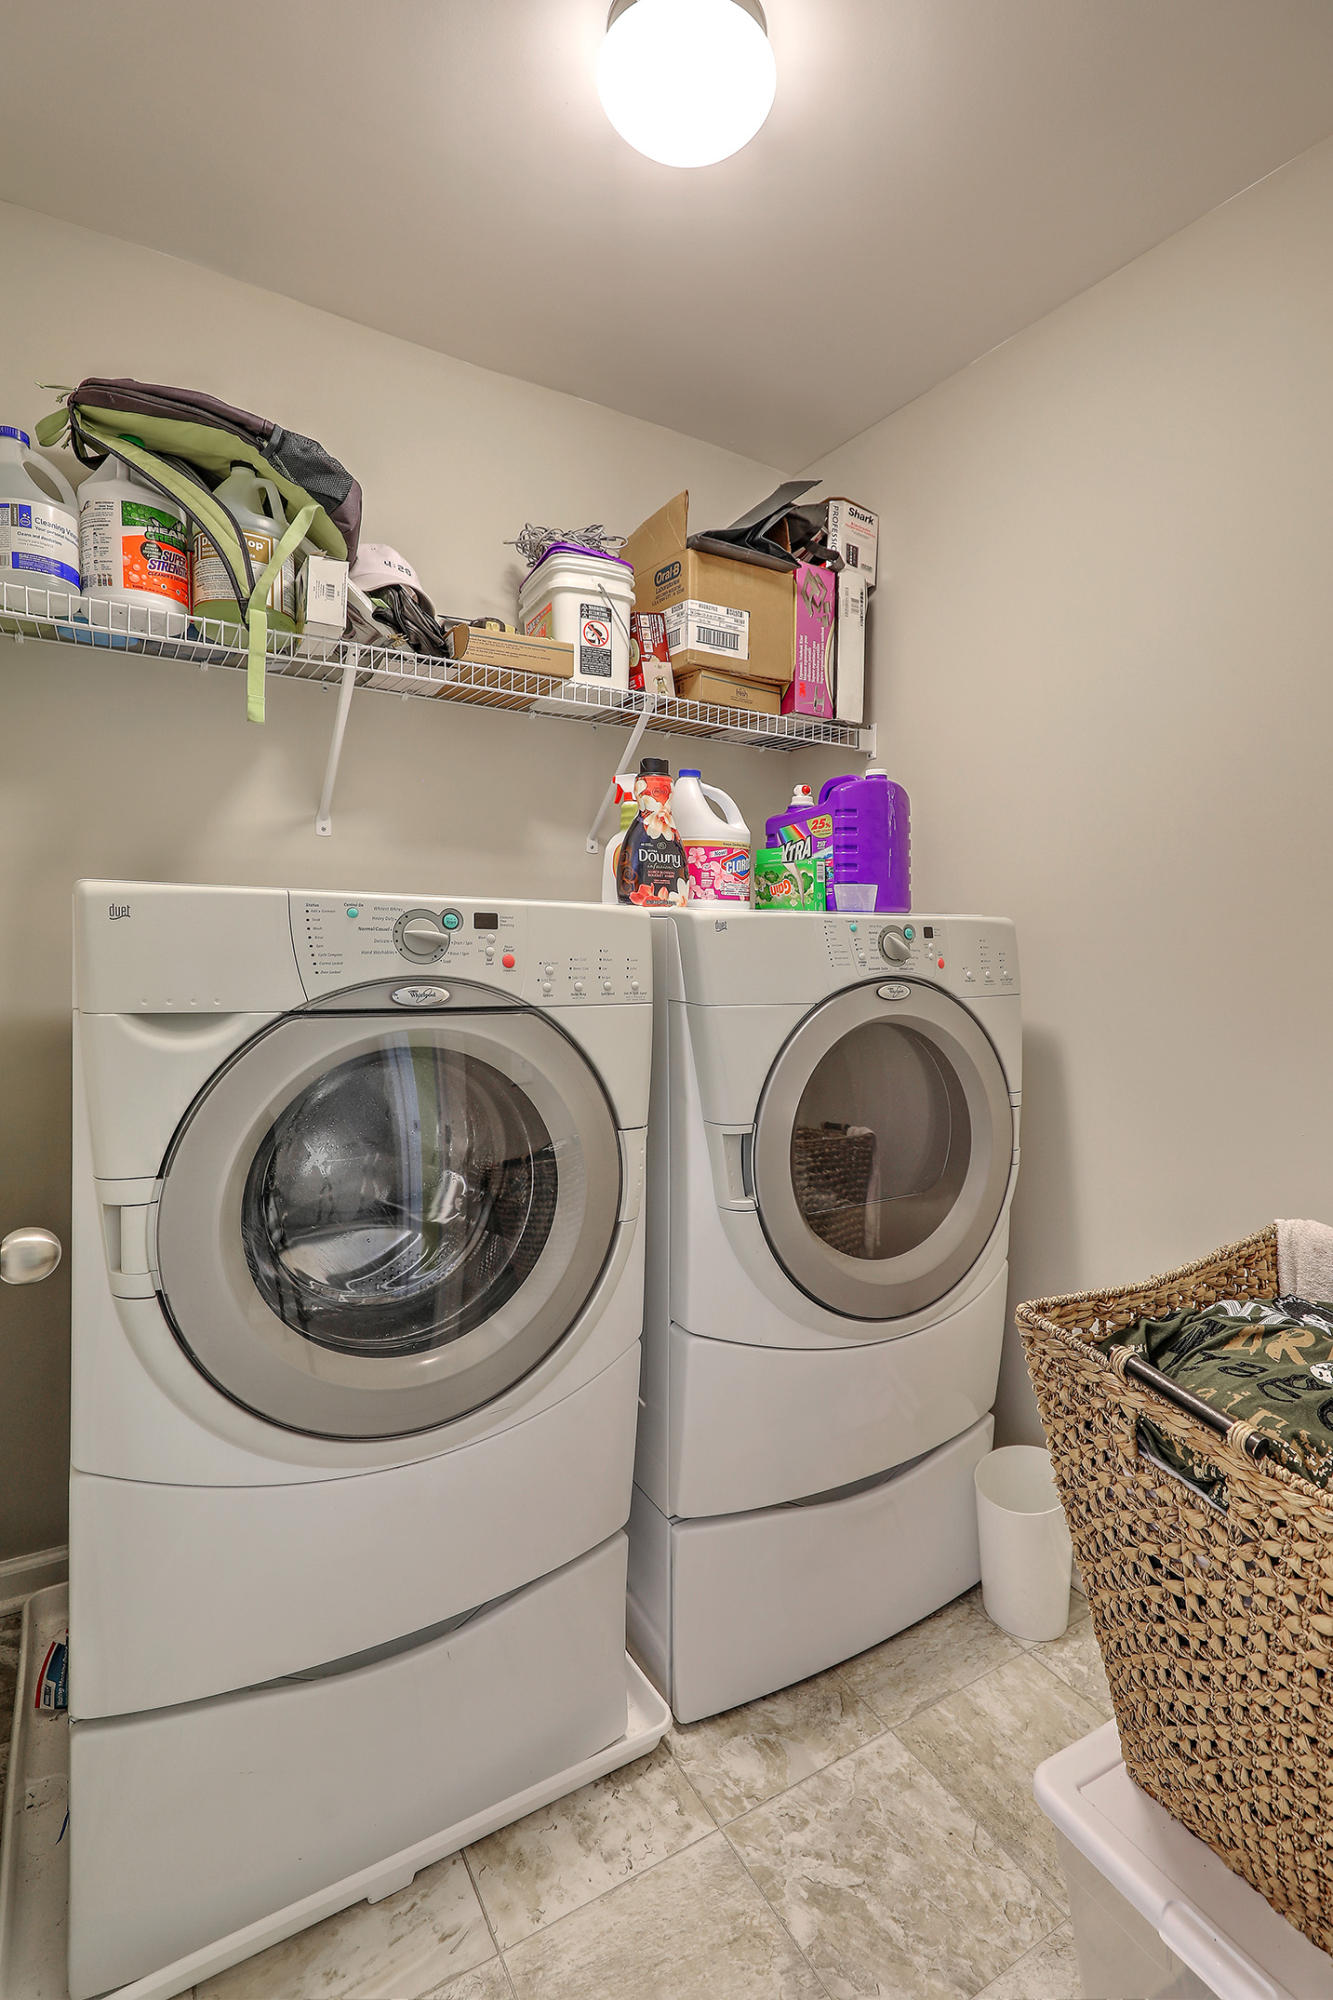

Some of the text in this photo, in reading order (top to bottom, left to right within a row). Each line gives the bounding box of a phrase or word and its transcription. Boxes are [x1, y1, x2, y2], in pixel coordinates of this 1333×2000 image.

[35, 516, 66, 534] Cleaning
[848, 507, 874, 526] Shark
[830, 505, 839, 551] PROFESSIO
[781, 835, 812, 863] XTRA
[638, 849, 681, 868] Downy
[770, 879, 791, 897] Gain
[109, 903, 131, 920] duet
[408, 988, 436, 1003] Whirlpool
